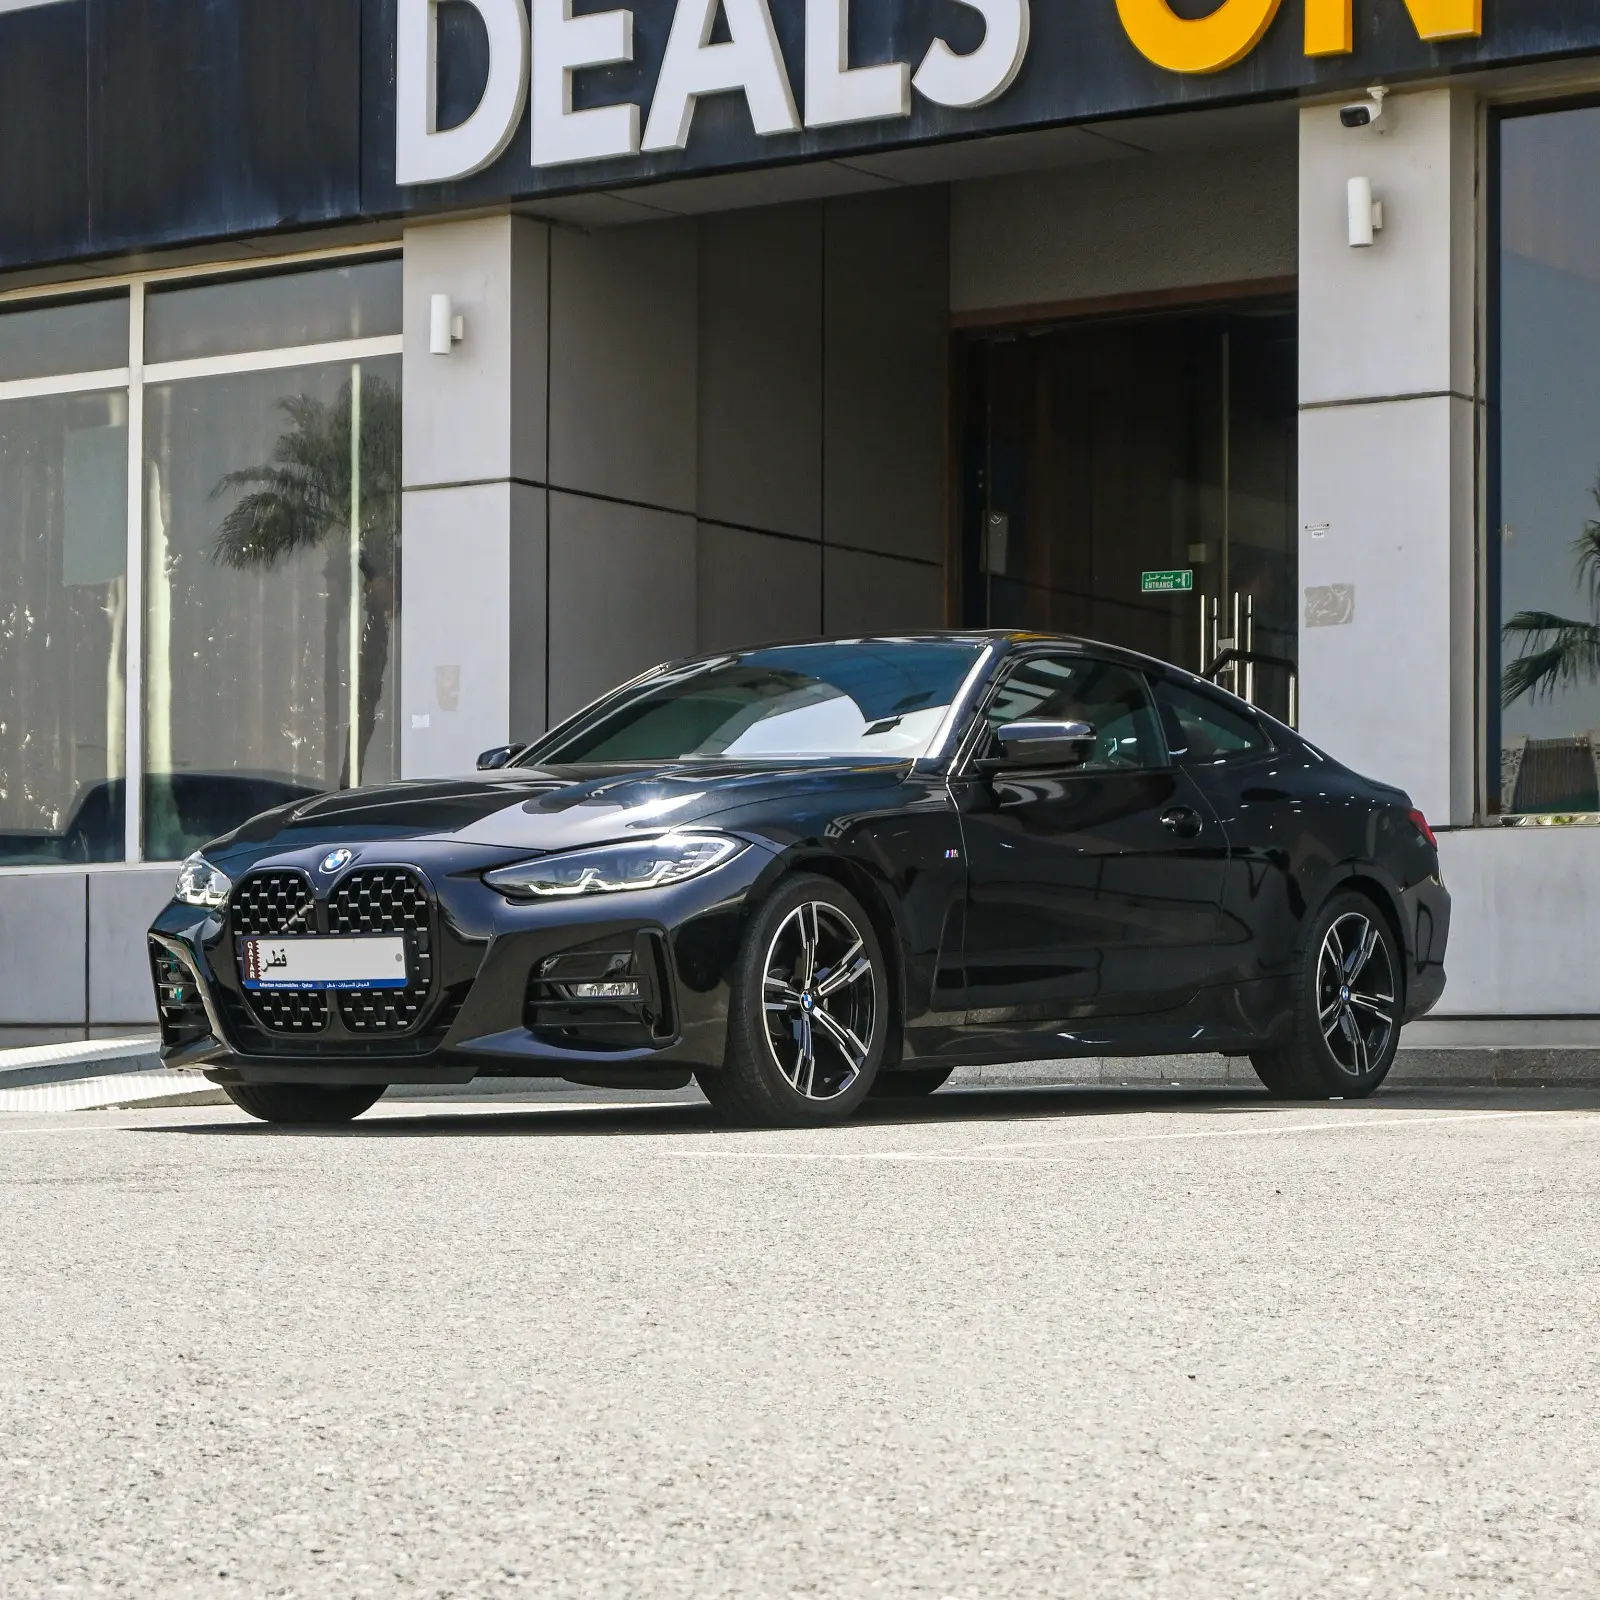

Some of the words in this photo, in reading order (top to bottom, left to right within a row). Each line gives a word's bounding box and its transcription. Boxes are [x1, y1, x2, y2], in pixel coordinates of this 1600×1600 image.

[1144, 581, 1174, 589] ENTRANCE
[1145, 573, 1174, 582] مدخل
[247, 941, 256, 979] QATAR
[261, 948, 287, 973] قطر
